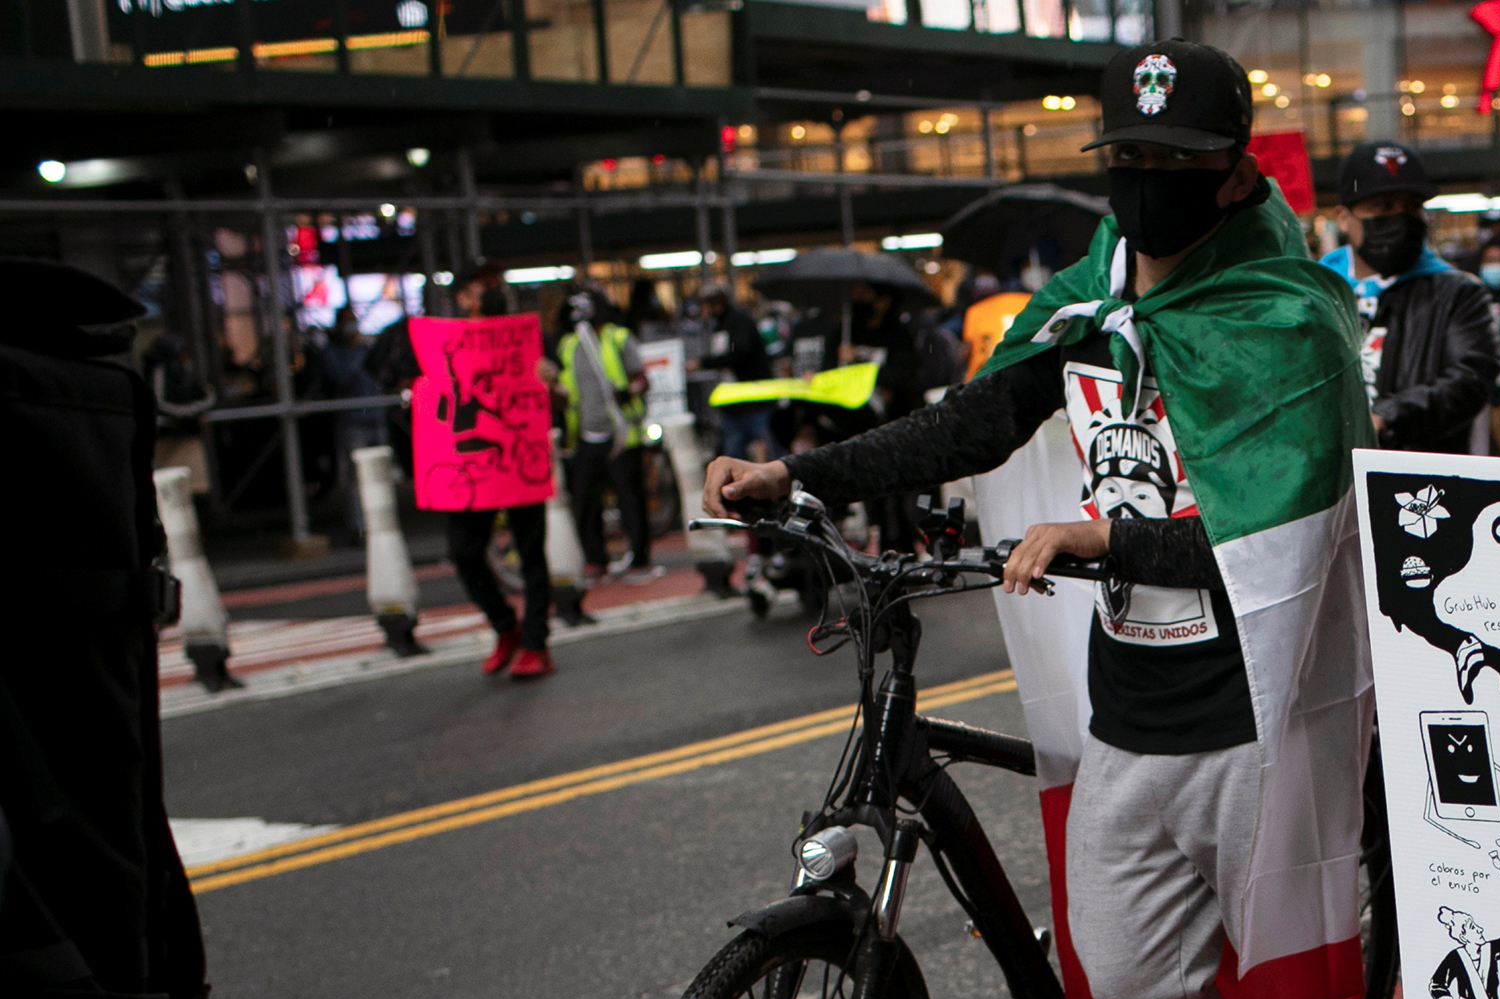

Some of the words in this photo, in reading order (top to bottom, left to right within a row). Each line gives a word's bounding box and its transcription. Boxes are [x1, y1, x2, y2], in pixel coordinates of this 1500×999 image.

[1096, 428, 1162, 469] DEMANDS
[1158, 621, 1208, 640] UNIDOS
[1428, 862, 1466, 877] Cobros
[1472, 871, 1491, 883] por
[1430, 875, 1441, 887] el
